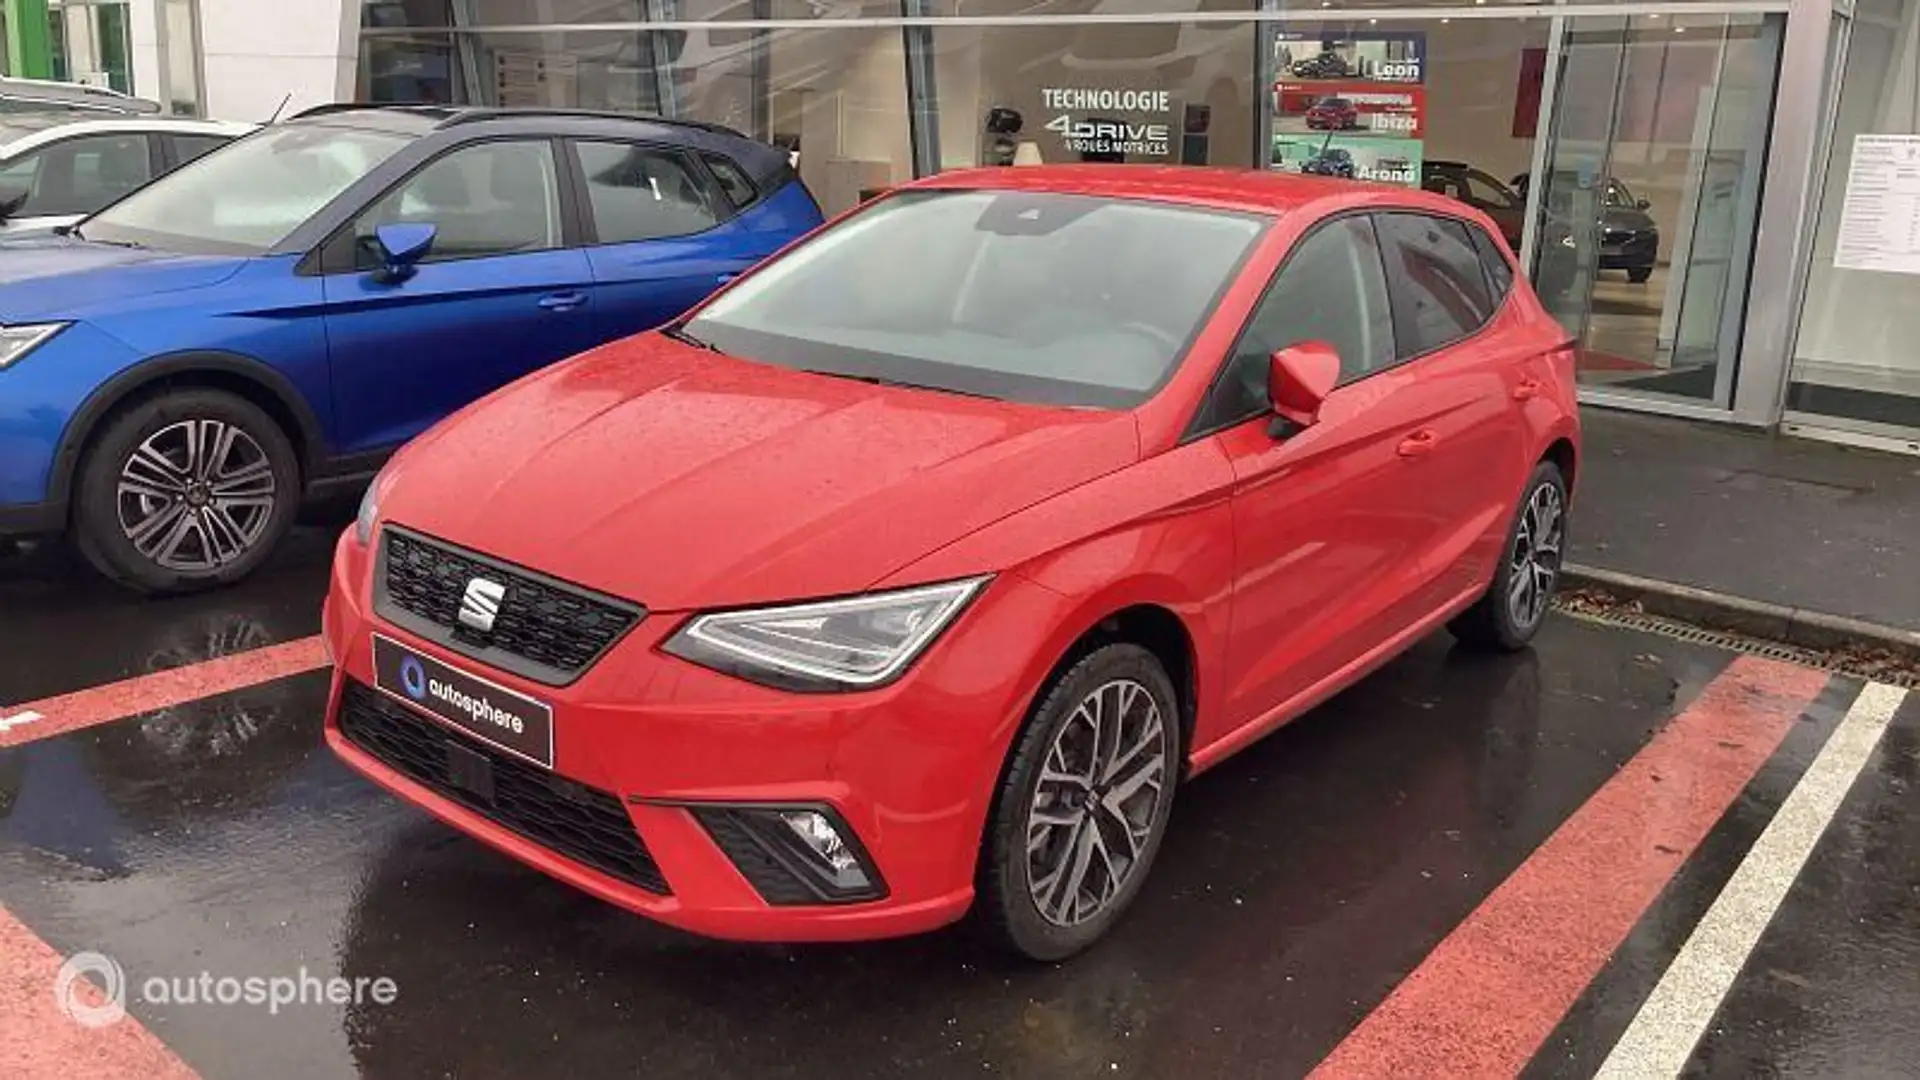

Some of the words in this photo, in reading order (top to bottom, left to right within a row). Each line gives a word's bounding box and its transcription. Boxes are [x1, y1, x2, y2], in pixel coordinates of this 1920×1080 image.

[1041, 88, 1171, 112] TECHNOLOGIE
[1112, 141, 1170, 155] MOTRICES
[428, 677, 525, 735] autosphere
